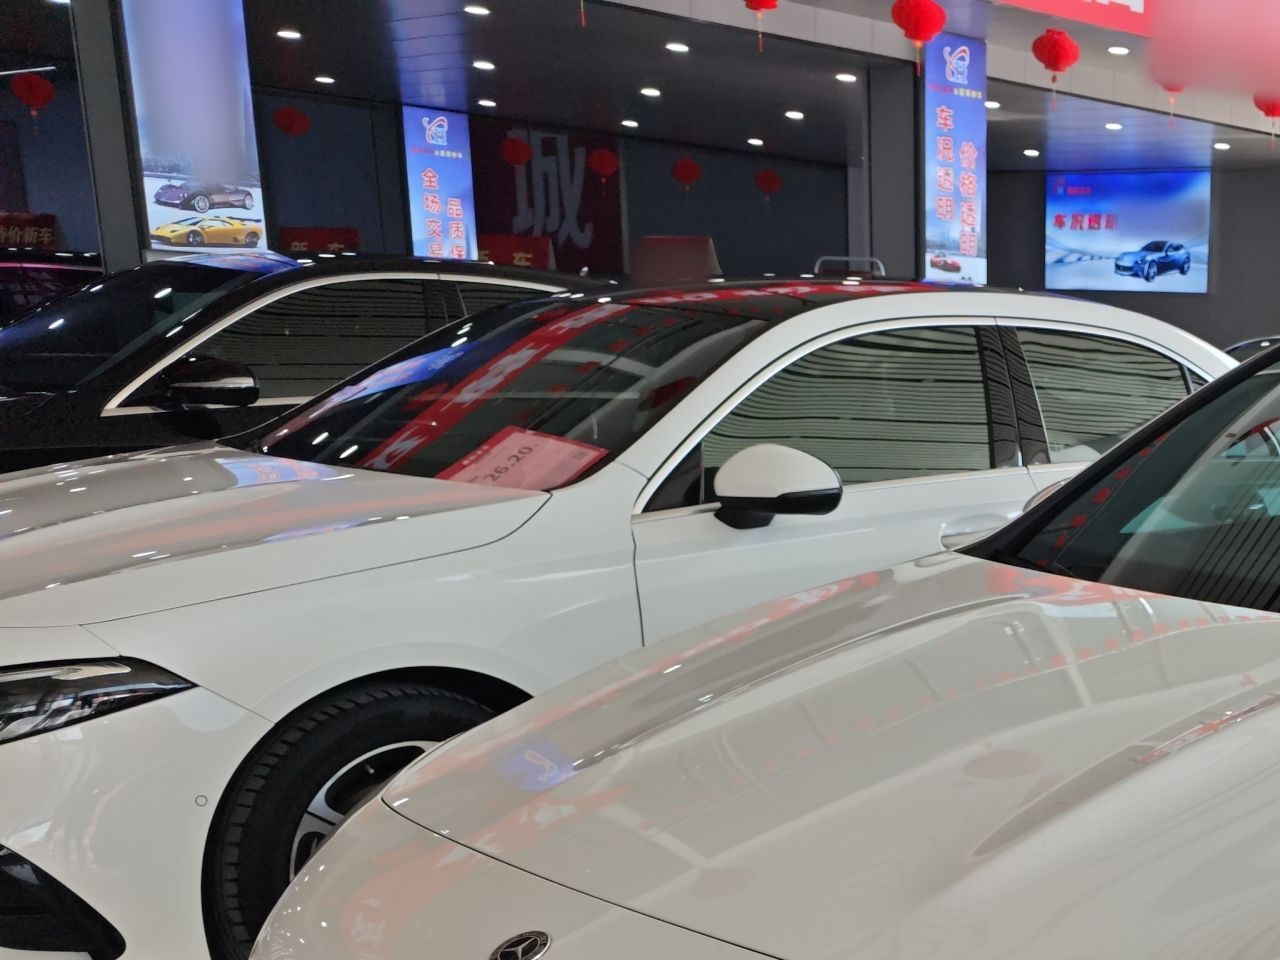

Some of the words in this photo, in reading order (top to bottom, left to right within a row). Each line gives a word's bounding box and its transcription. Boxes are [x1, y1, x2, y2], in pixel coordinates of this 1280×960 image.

[421, 167, 443, 258] 全场交易
[935, 105, 954, 222] 车况透明
[959, 141, 978, 257] 价格透明
